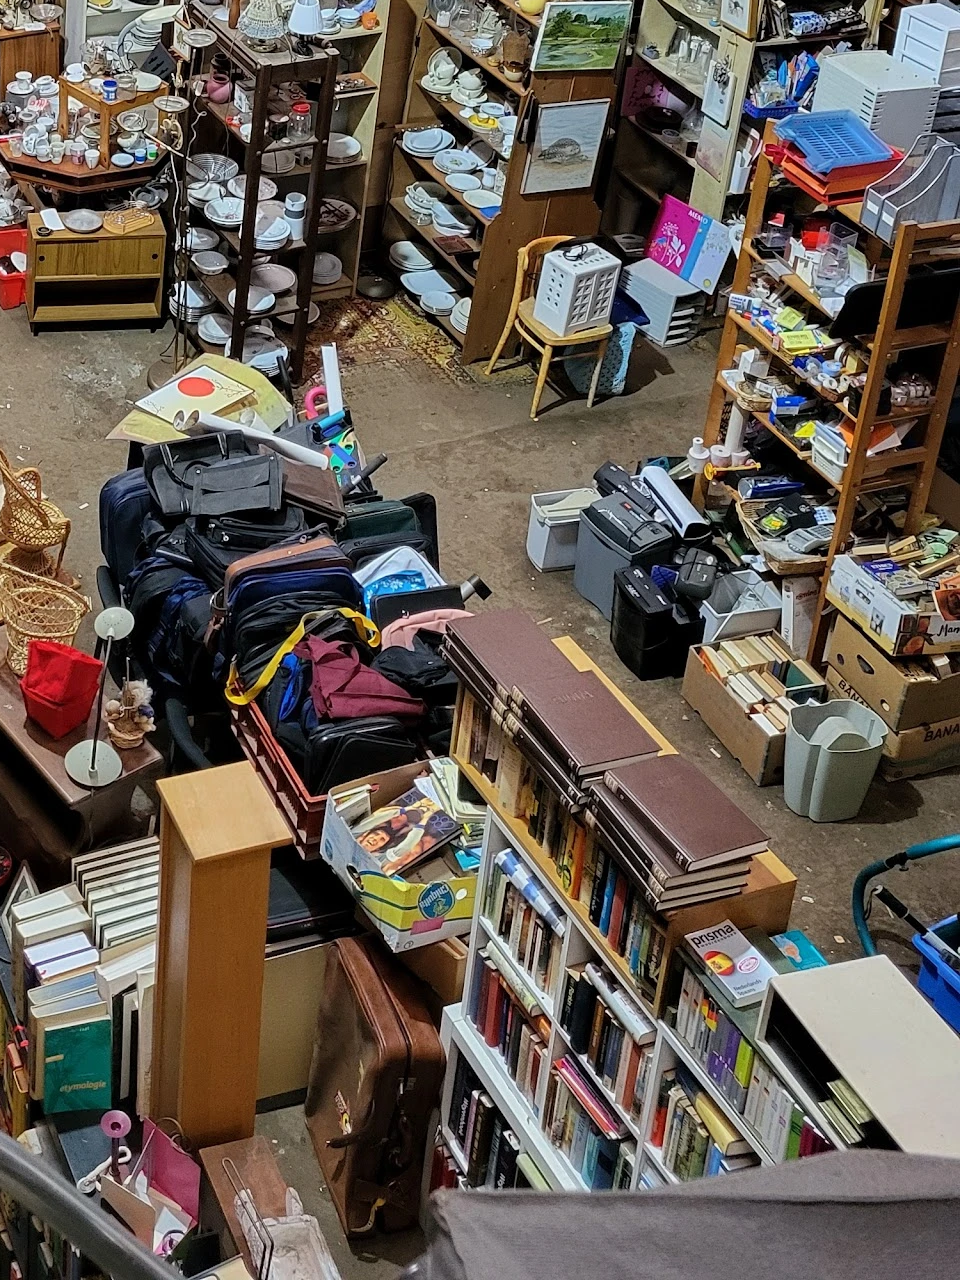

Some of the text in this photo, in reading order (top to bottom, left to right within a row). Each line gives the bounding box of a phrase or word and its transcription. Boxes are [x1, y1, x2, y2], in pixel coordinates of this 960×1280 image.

[688, 210, 709, 225] MEMO
[418, 882, 450, 909] Chiquita
[691, 924, 735, 949] prisma
[733, 979, 762, 992] Nederlands
[59, 1080, 107, 1094] etymologie
